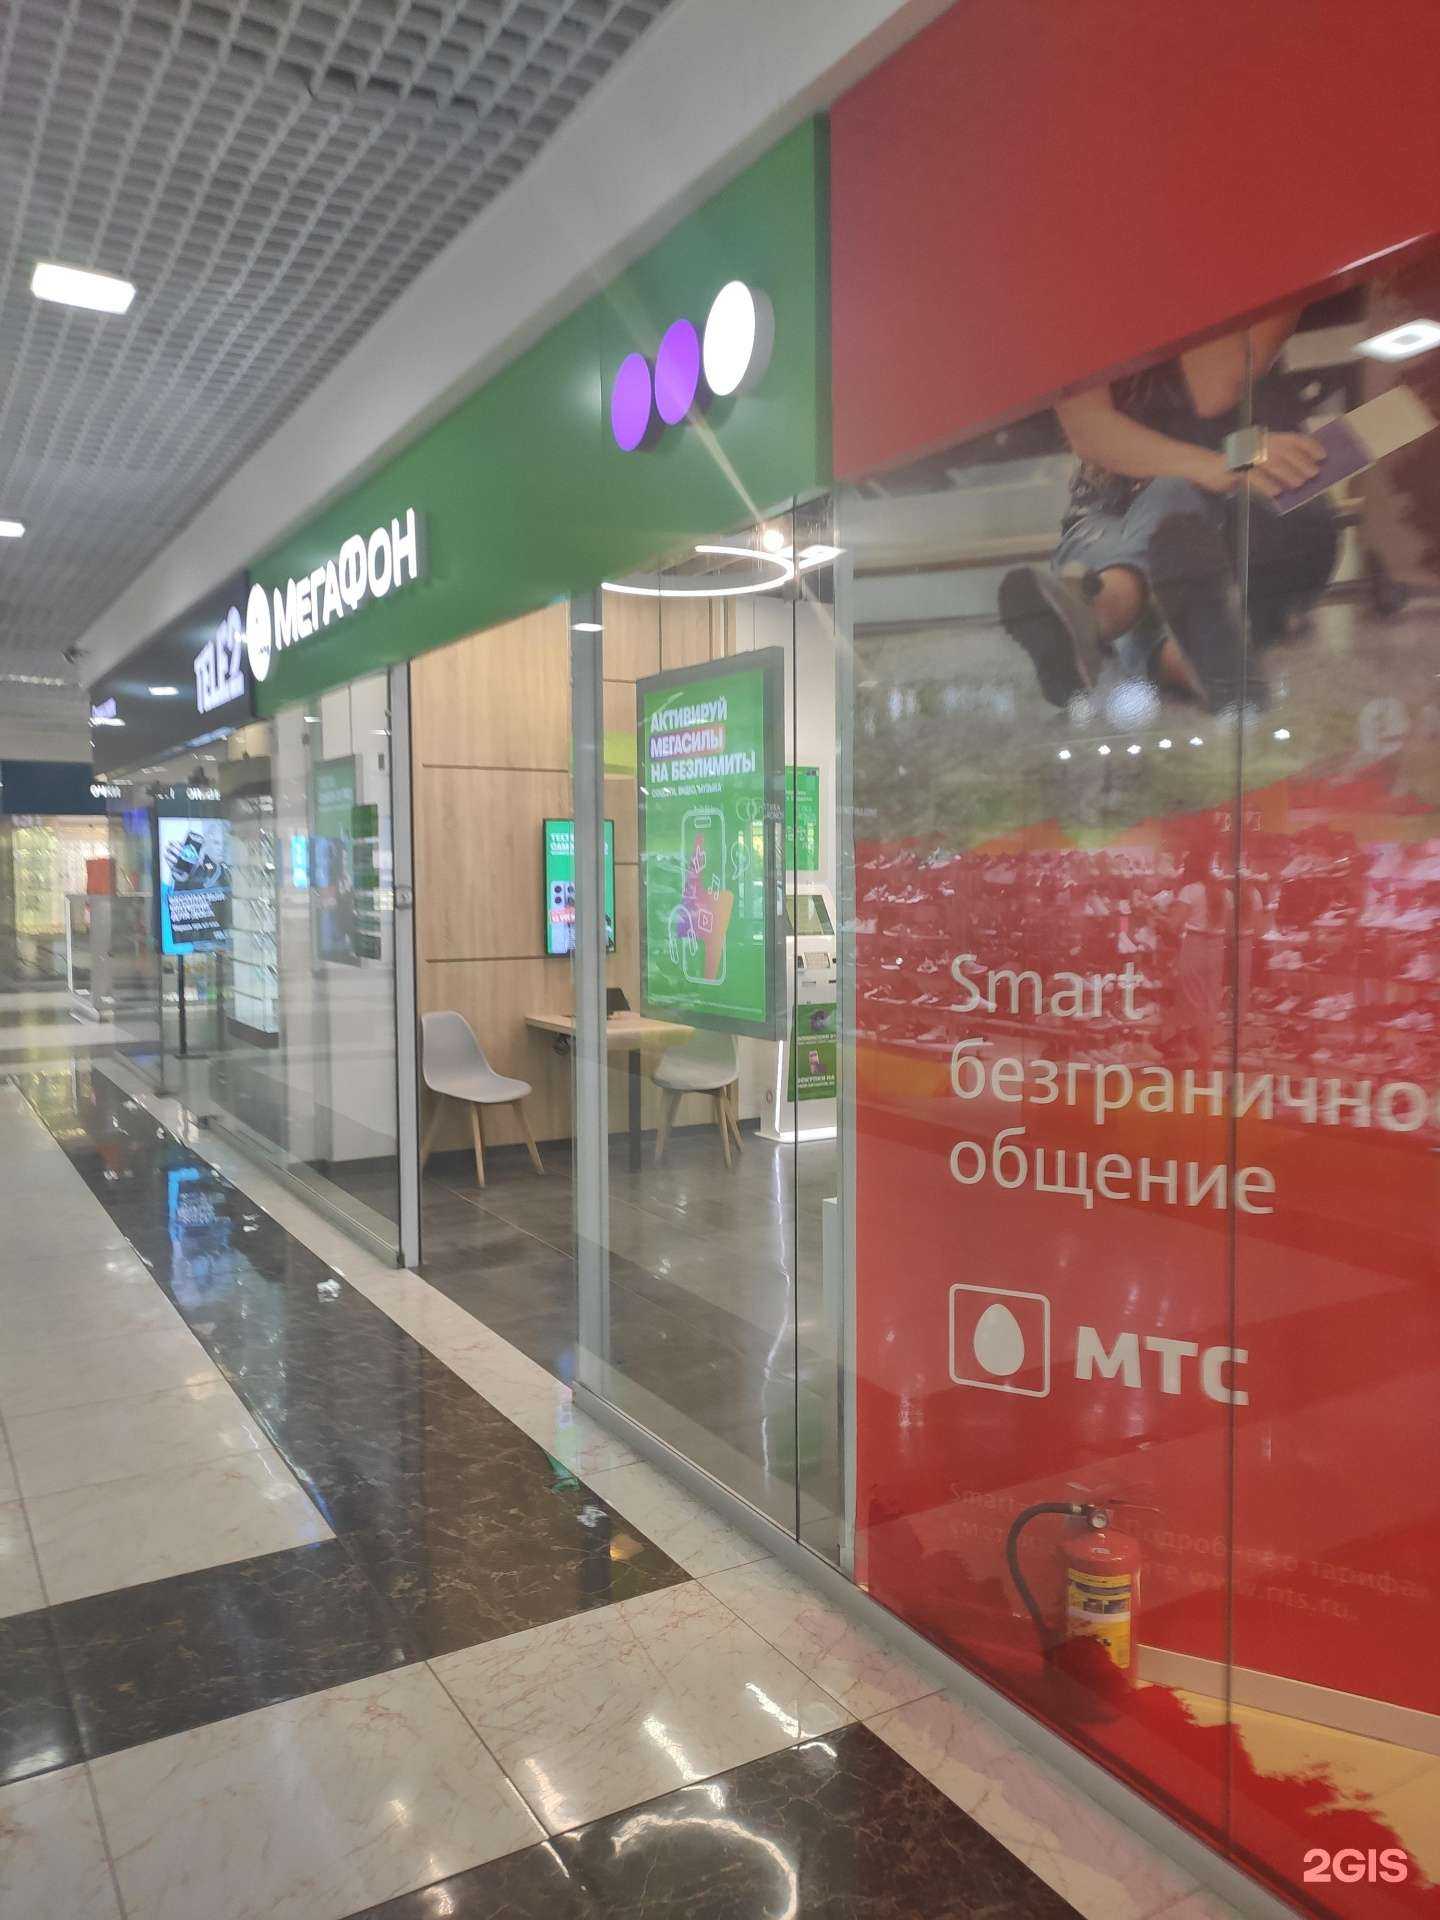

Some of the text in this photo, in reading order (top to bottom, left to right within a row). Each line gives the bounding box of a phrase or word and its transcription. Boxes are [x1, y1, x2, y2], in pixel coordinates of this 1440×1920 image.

[272, 507, 419, 651] МЕГАФОН
[650, 696, 728, 734] АКТИВИРУЙ
[650, 727, 724, 759] МЕГАСИЛЫ
[651, 750, 756, 784] НА БЕЗЛИМИТЫ
[950, 952, 1145, 1021] Smart
[950, 1037, 1440, 1133] безгранично
[950, 1126, 1276, 1215] общение
[1074, 1325, 1249, 1406] МТС
